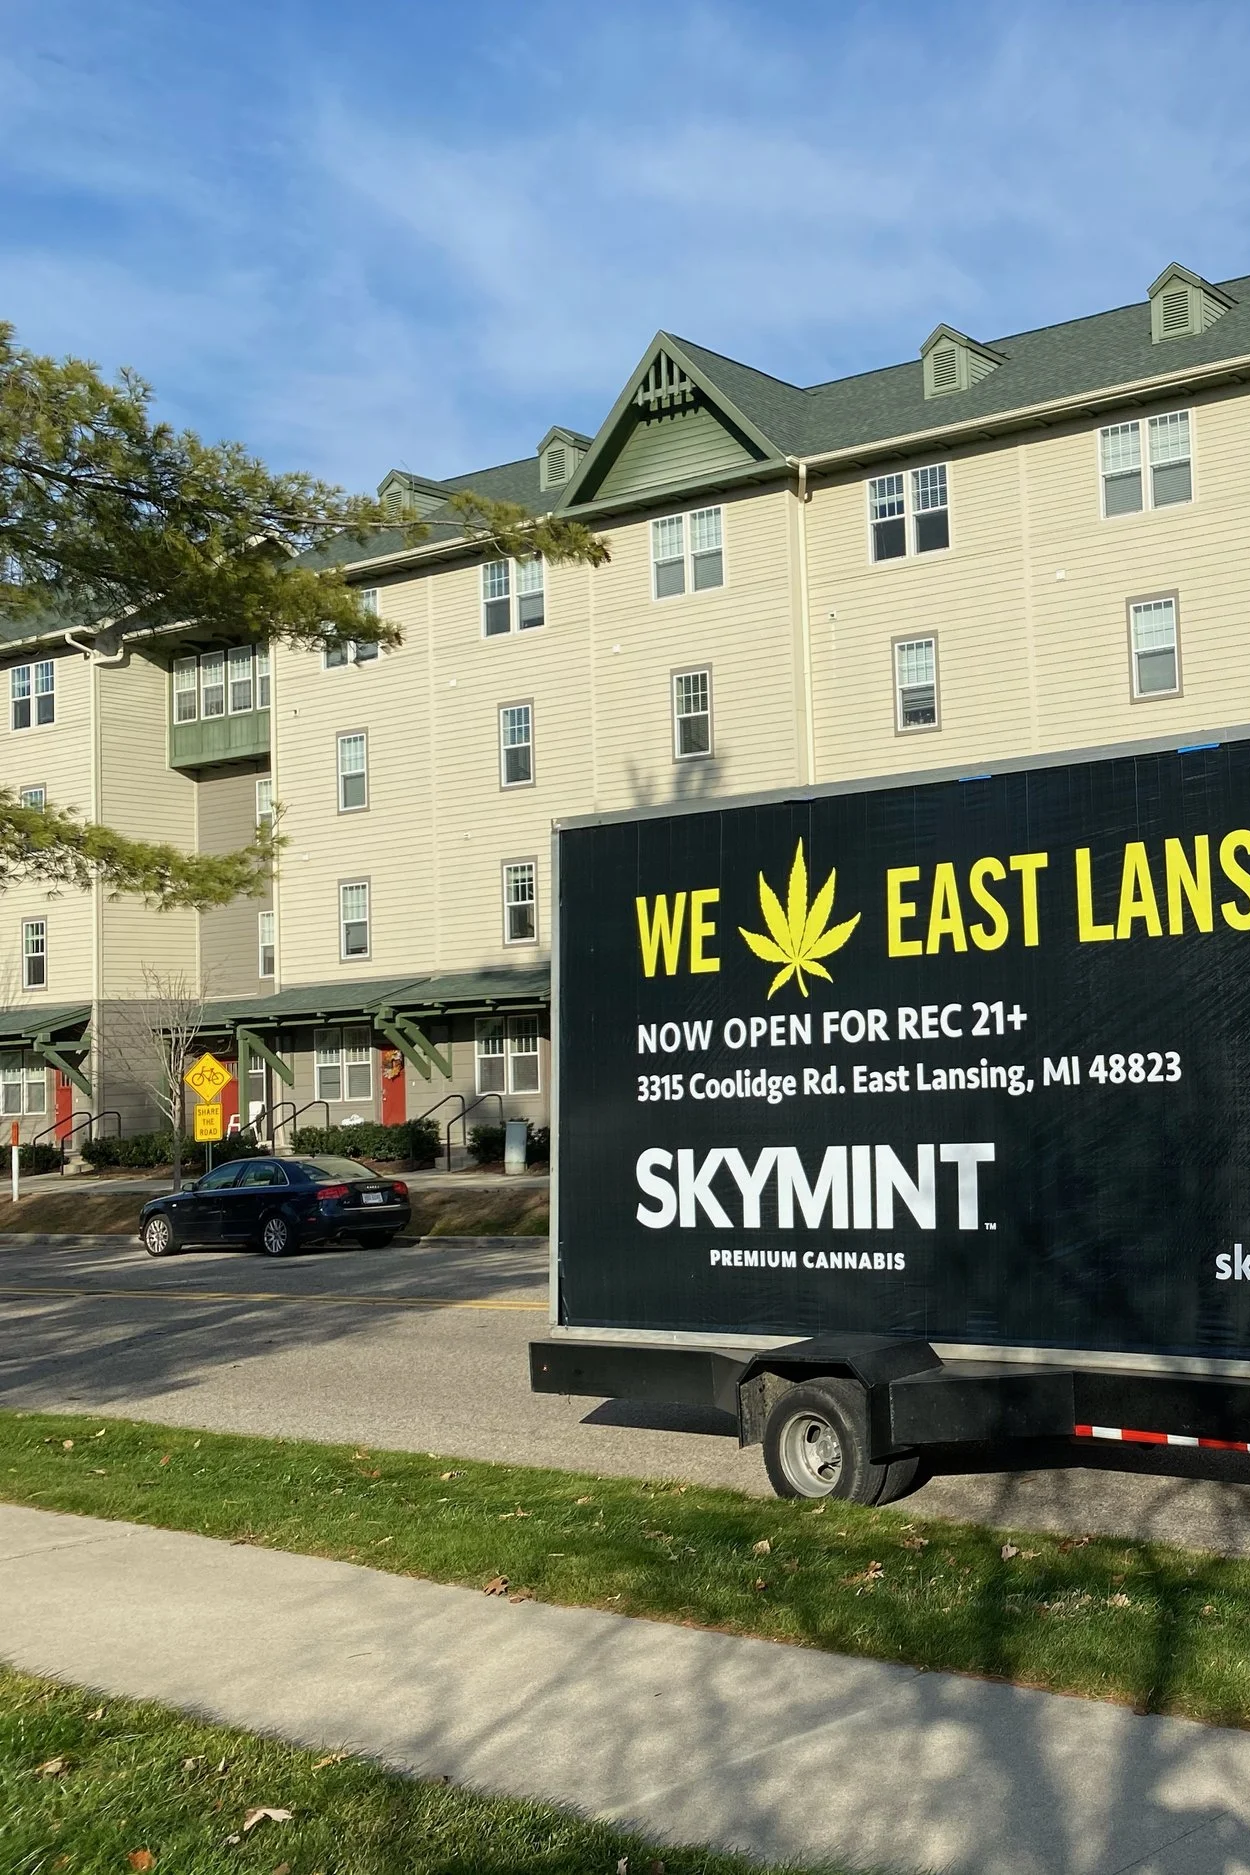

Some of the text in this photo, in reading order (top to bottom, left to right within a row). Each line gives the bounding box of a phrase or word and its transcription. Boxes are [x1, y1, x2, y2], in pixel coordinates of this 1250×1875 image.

[635, 887, 721, 978] WE
[886, 852, 1048, 958] EAST
[637, 1000, 1028, 1054] NOW OPEN FOR REC 21+
[637, 1051, 1182, 1105] 3315 Coolidge Rd. East Lansing, MI 48823
[197, 1107, 219, 1116] SHARE
[199, 1128, 218, 1136] ROAD
[635, 1142, 996, 1230] SKYMINT
[709, 1249, 906, 1271] PREMIUM CANNABIS
